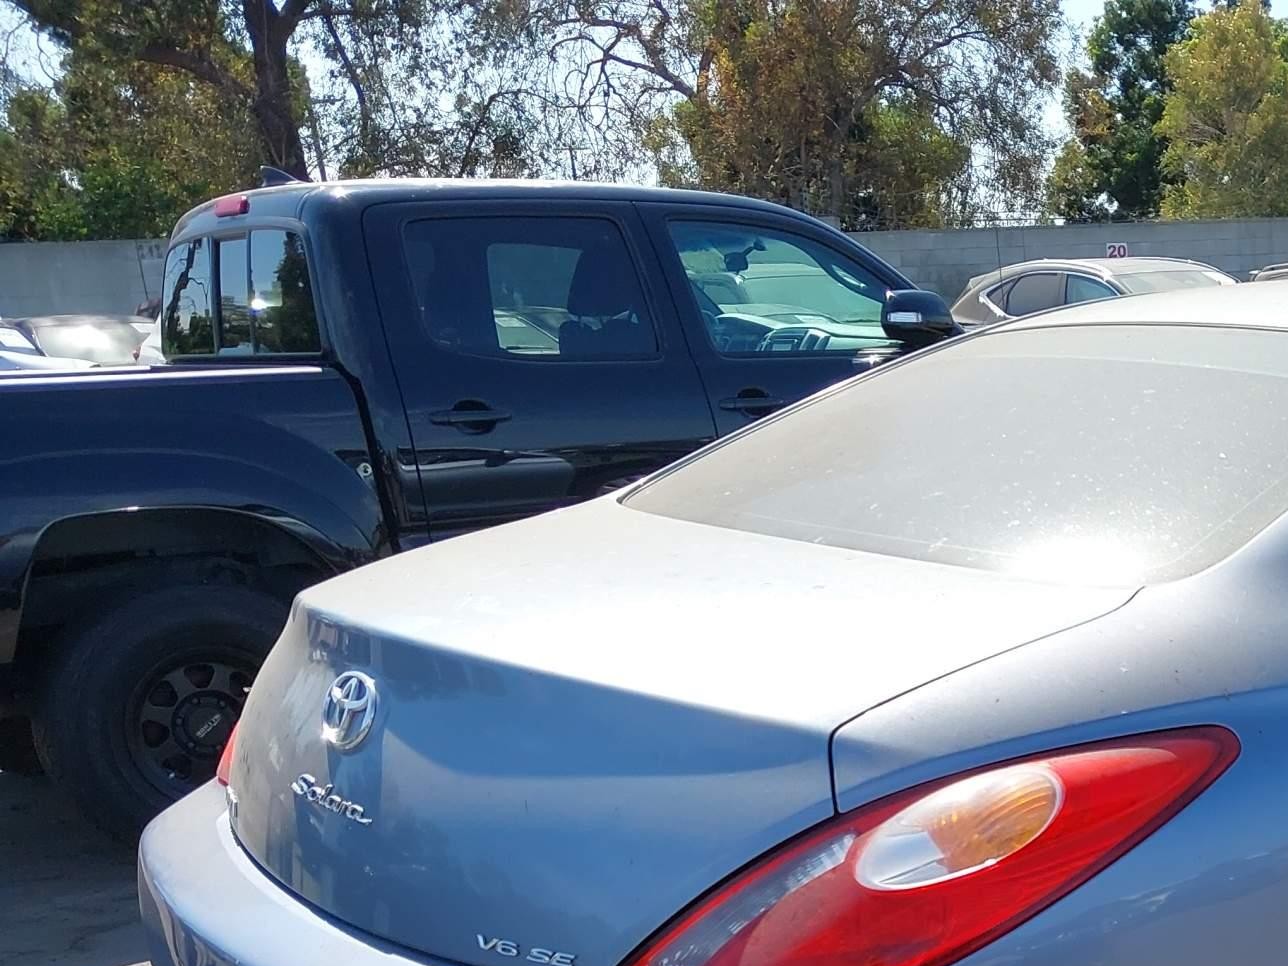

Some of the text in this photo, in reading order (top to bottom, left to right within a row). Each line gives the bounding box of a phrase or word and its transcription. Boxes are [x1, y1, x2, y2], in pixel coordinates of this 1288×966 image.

[1108, 245, 1127, 258] 20
[291, 773, 373, 824] Solara
[476, 934, 519, 957] V6
